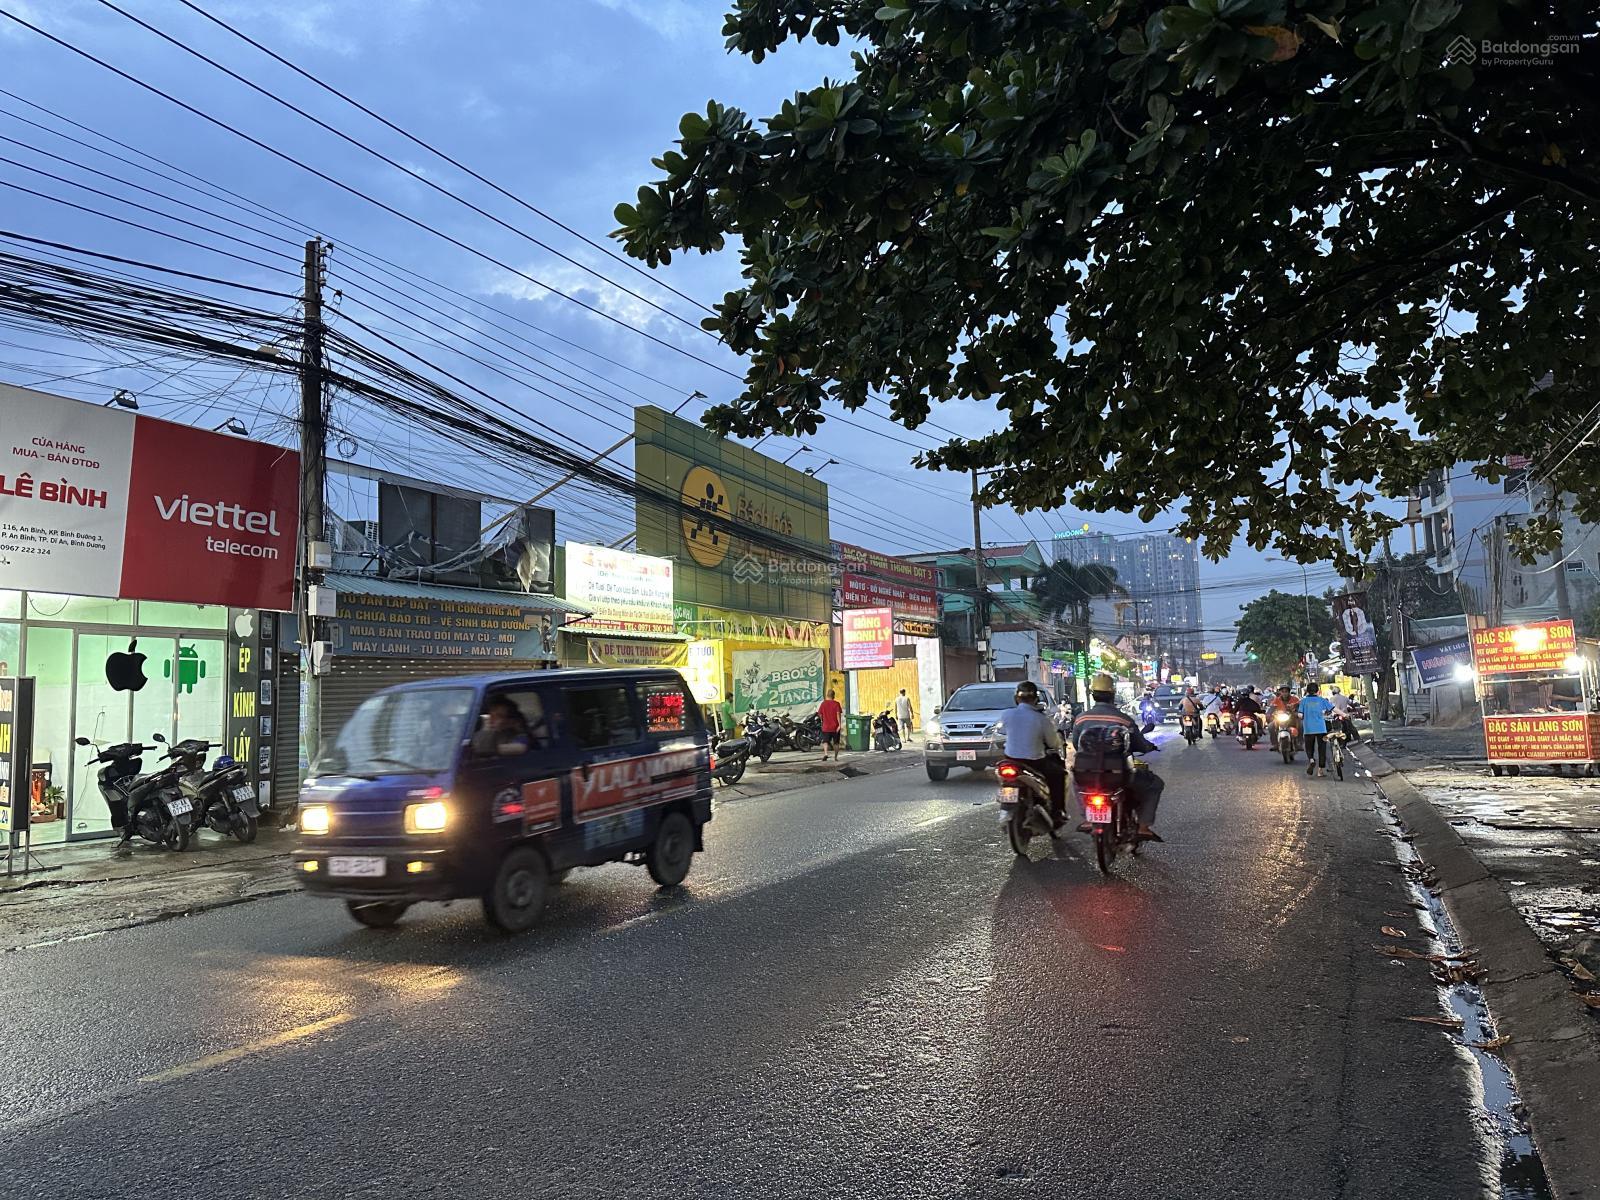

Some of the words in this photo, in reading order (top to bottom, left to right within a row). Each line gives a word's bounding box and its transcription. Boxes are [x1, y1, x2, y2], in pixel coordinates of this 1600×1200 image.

[32, 437, 53, 448] CỬA
[55, 441, 85, 454] HÀNG
[12, 447, 38, 459] MUA
[47, 452, 70, 464] BÁN
[0, 472, 34, 499] LÊ
[40, 477, 108, 509] BÌNH
[154, 494, 280, 536] viettel
[0, 544, 20, 552] 0967
[206, 536, 278, 560] telecom
[456, 618, 478, 628] SINH
[350, 625, 376, 637] MUA
[405, 629, 431, 640] TRAO
[1476, 630, 1496, 647] ĐẶC
[1550, 625, 1572, 639] SƠN
[238, 642, 251, 673] ÉP
[381, 642, 410, 655] LẠNH
[436, 645, 462, 657] LẠNH
[233, 687, 255, 718] KÍNH
[769, 689, 779, 705] 2
[1488, 719, 1508, 735] ĐẶC
[1510, 718, 1531, 733] SẢN
[1533, 720, 1559, 735] LẠNG
[1562, 719, 1584, 732] SƠN
[233, 727, 251, 763] LẤY
